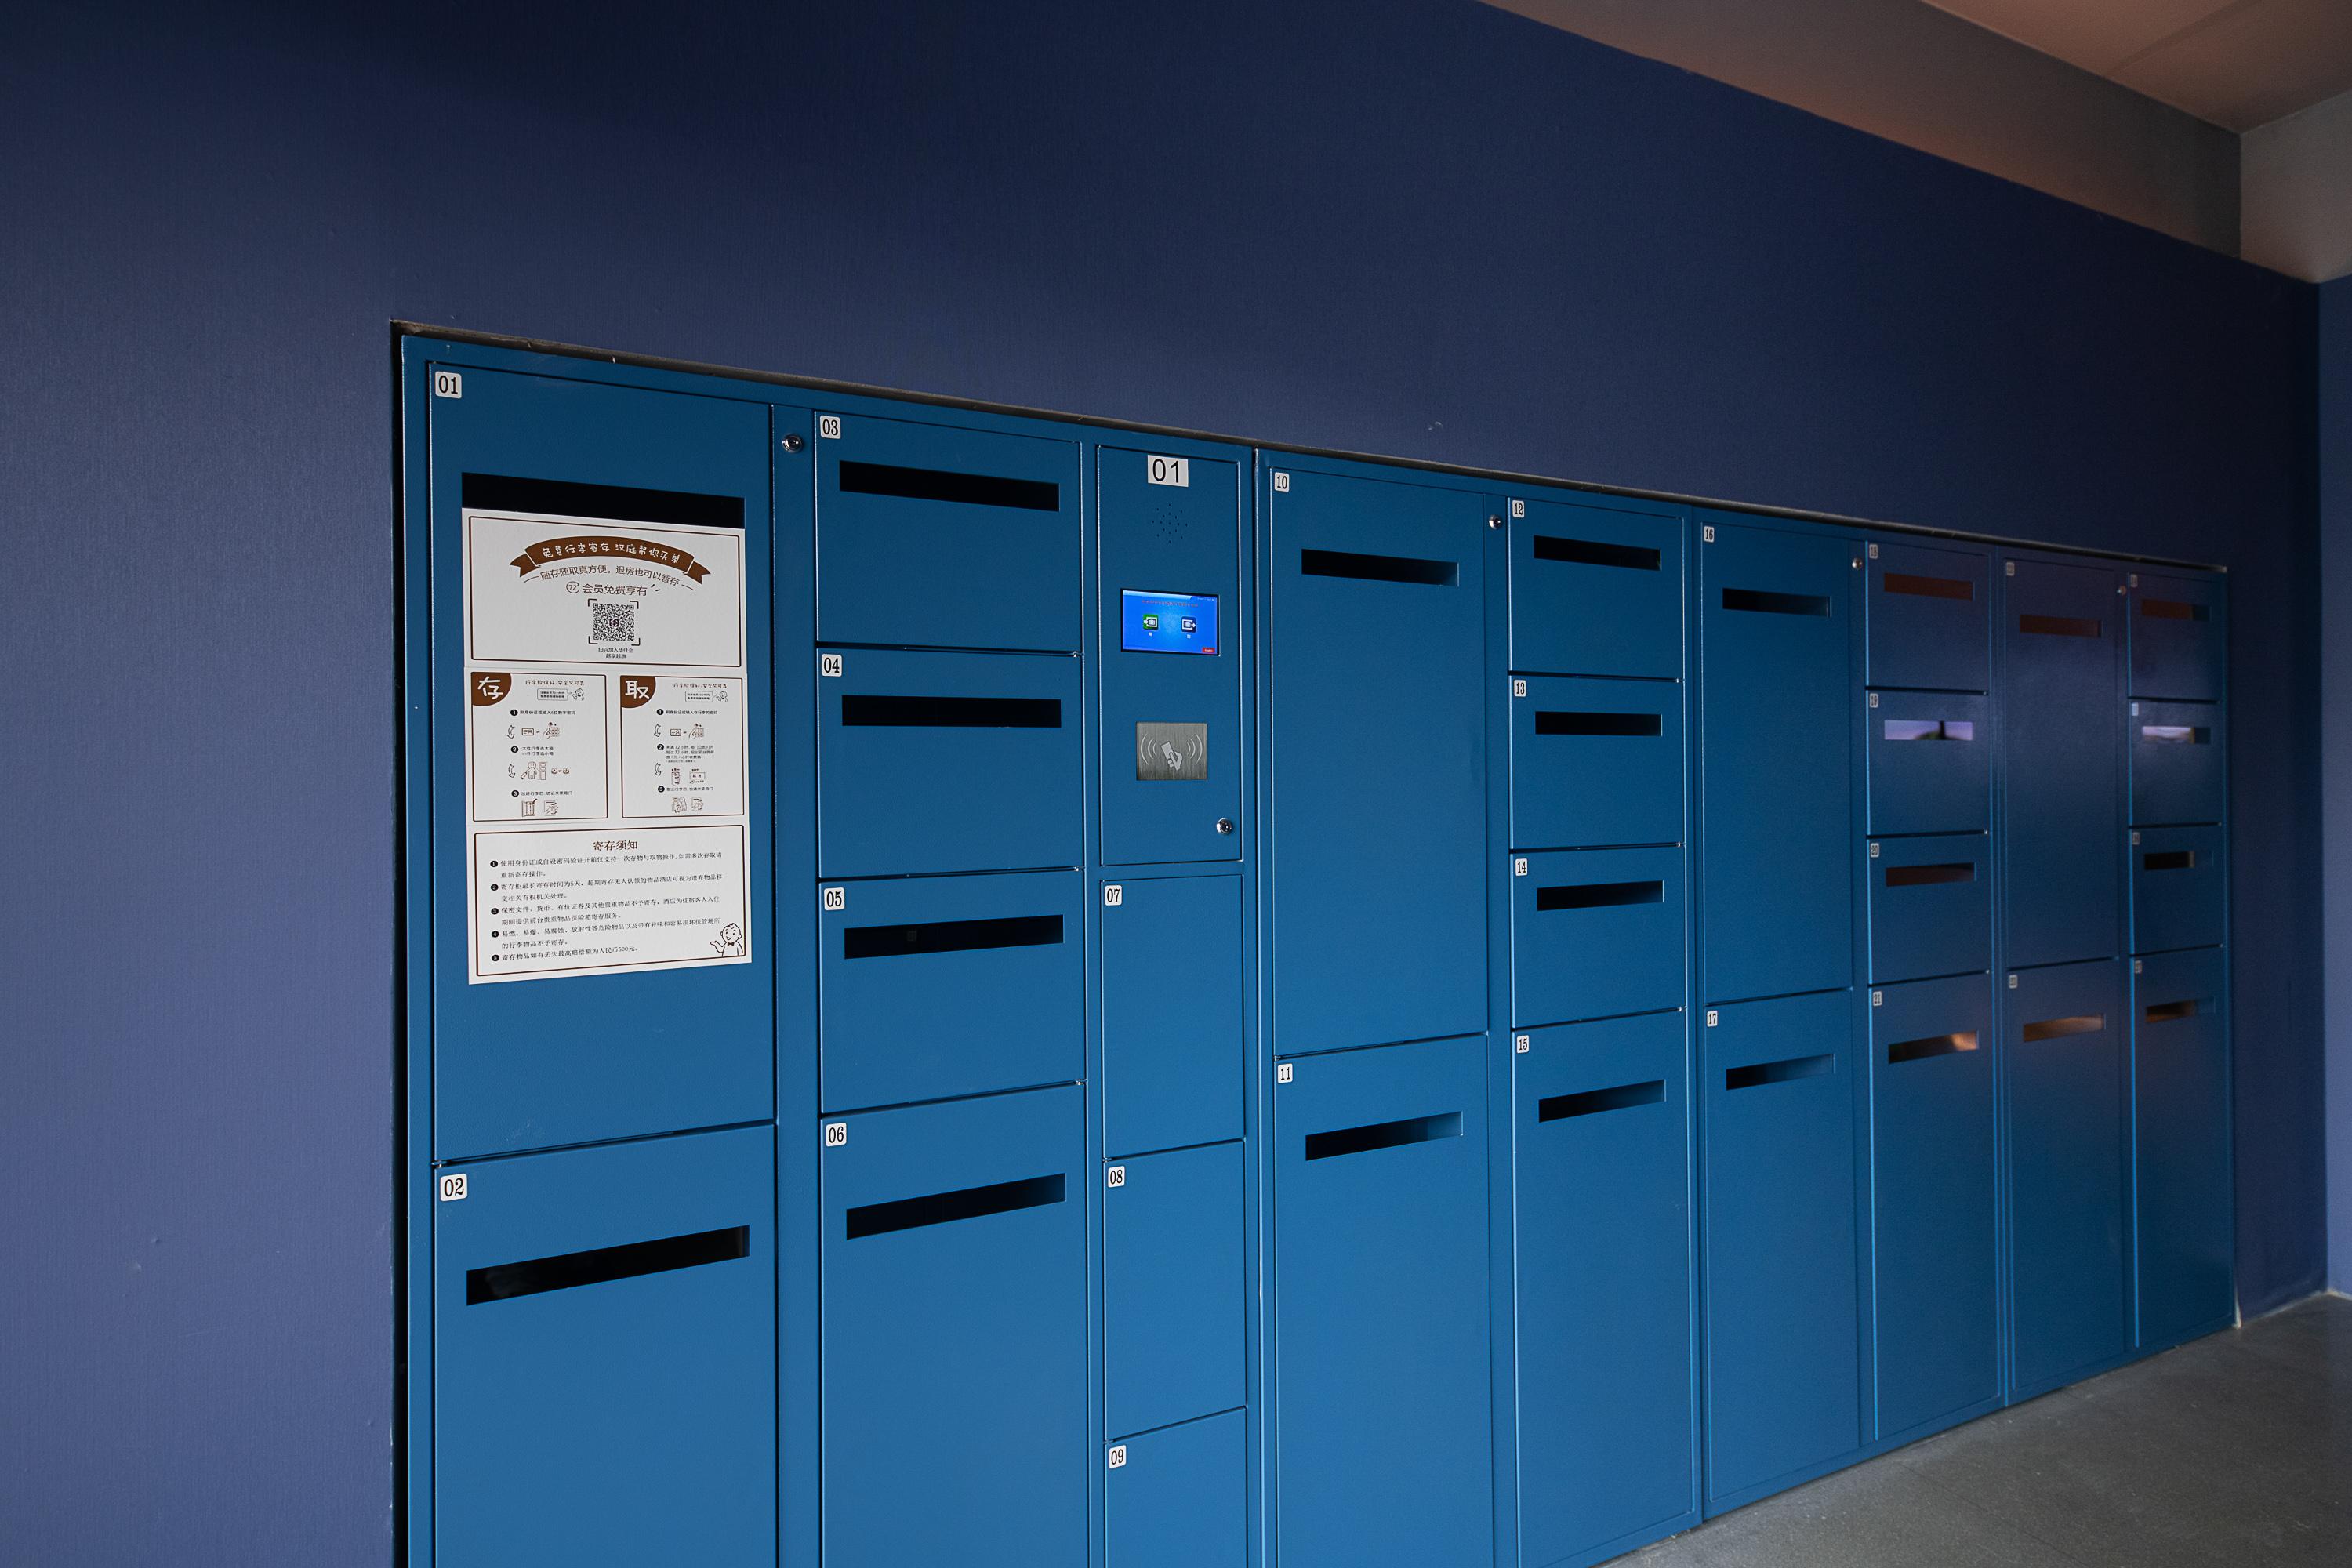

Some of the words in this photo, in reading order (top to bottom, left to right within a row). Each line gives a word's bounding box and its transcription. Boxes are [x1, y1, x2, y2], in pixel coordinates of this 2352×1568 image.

[438, 375, 459, 395] 01
[822, 419, 839, 436] 03
[1152, 458, 1179, 483] 01
[1276, 474, 1288, 489] 10
[1514, 502, 1523, 516] 12
[1705, 528, 1714, 540] 16
[543, 542, 610, 558] 免费行李寄存
[615, 543, 681, 564] 汉庭帮你买单
[583, 583, 648, 596] 会员免费享有
[824, 657, 840, 673] 04
[477, 676, 504, 700] 存
[625, 680, 650, 699] 取
[1515, 681, 1525, 695] 13
[593, 840, 638, 851] 寄存须知
[1517, 861, 1526, 874] 14
[826, 891, 843, 907] 05
[1107, 888, 1120, 902] 07
[1708, 1012, 1716, 1025] 17
[1519, 1038, 1528, 1051] 15
[1281, 1066, 1291, 1080] 11
[828, 1126, 844, 1143] 06
[1110, 1169, 1123, 1185] 08
[444, 1178, 464, 1197] 02
[1111, 1449, 1124, 1465] 09
